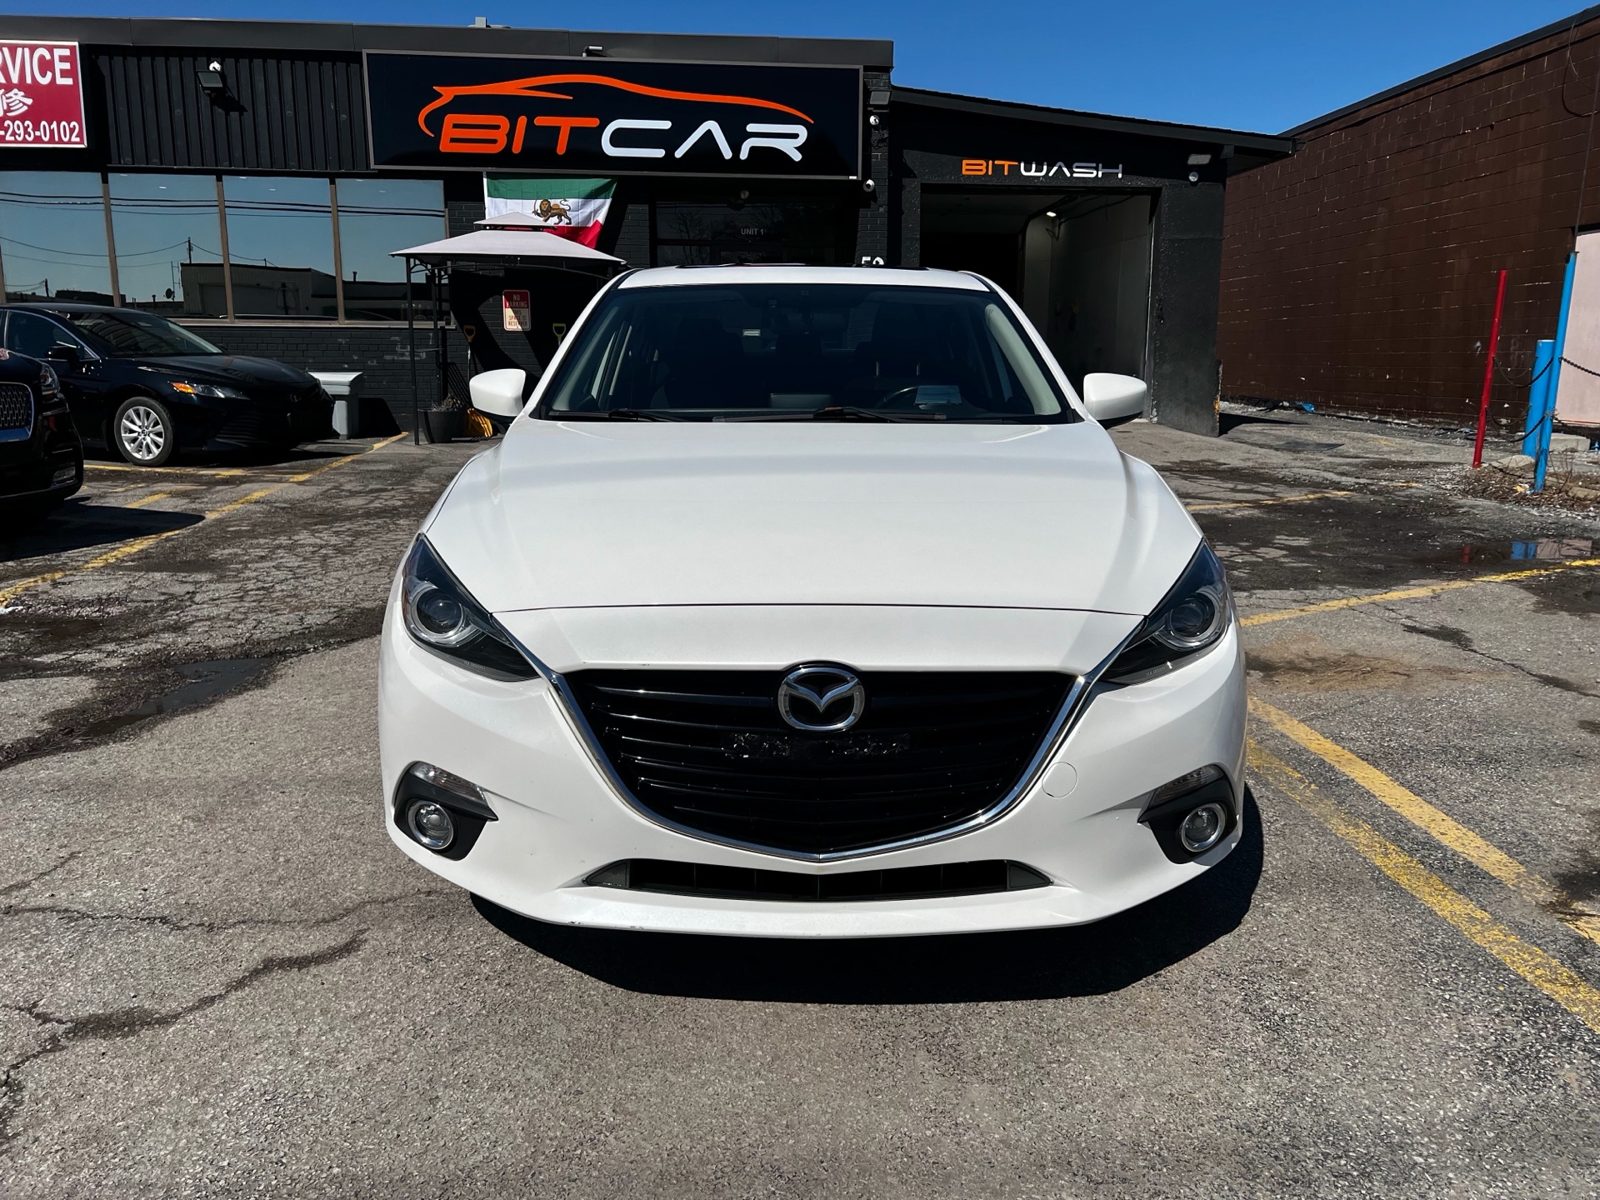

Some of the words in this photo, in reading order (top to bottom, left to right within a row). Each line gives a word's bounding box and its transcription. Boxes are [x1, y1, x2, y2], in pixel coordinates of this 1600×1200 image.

[439, 113, 808, 162] BITCAR
[961, 159, 1123, 179] BITWASH
[740, 227, 758, 236] UNIT
